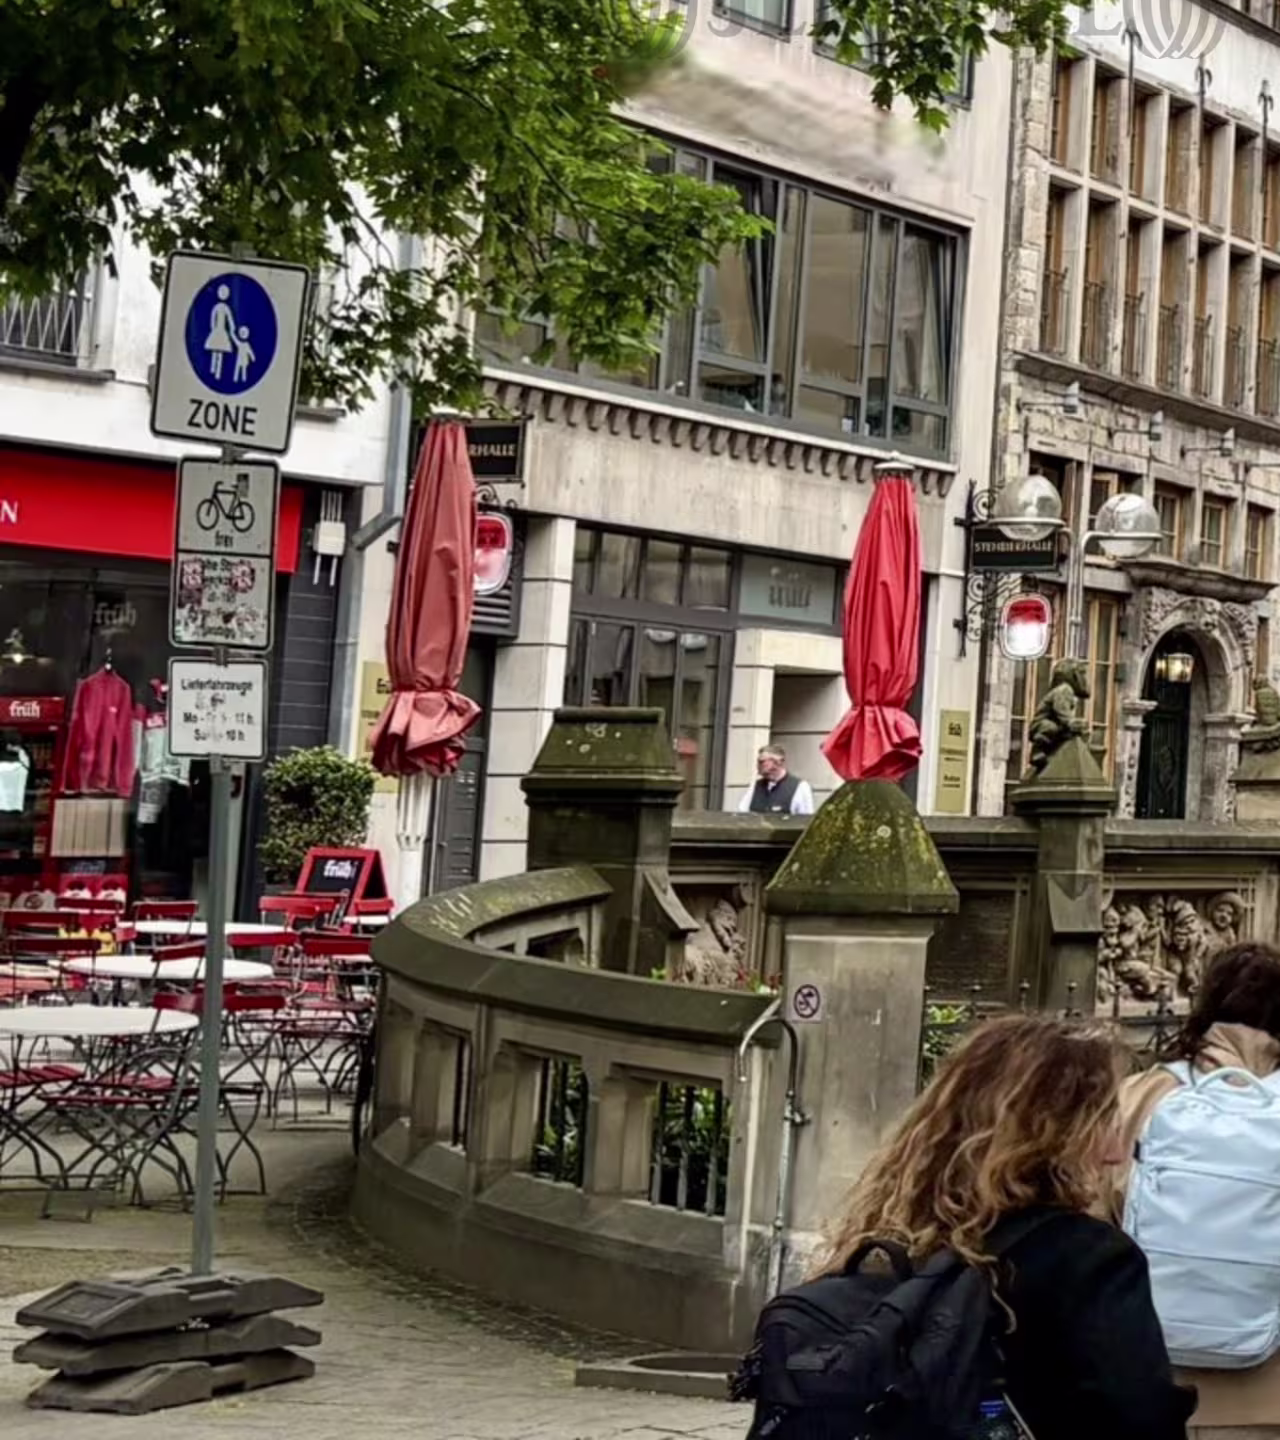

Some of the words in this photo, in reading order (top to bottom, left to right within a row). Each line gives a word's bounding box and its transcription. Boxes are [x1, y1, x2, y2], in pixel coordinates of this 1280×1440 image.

[187, 398, 258, 437] ZONE
[467, 442, 517, 457] RHALLE
[9, 699, 41, 718] früh
